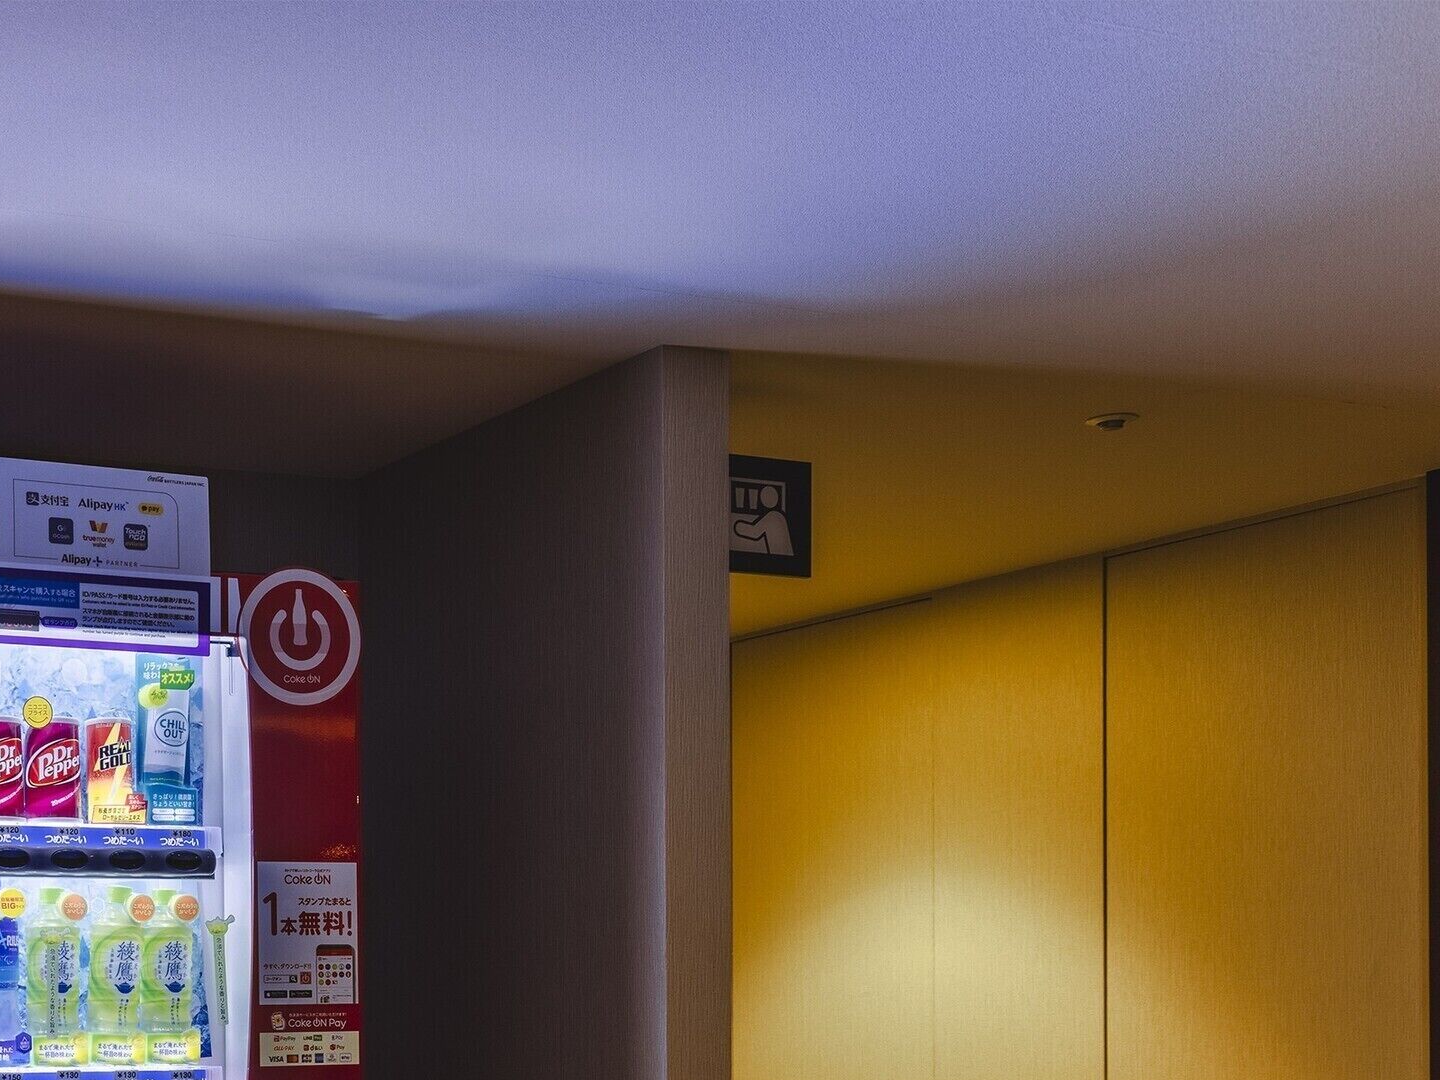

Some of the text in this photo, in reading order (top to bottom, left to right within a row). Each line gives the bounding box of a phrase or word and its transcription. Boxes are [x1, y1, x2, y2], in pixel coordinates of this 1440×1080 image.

[41, 495, 69, 506] 支付宝
[283, 674, 306, 684] Coke
[160, 718, 186, 731] CHILL
[164, 729, 183, 740] OUT
[53, 745, 73, 762] Dr
[284, 875, 312, 885] Coke
[298, 897, 352, 906] スタンプたまると
[116, 941, 135, 981] 綾鷹
[165, 941, 182, 981] 綾鷹
[288, 1019, 311, 1028] Coke
[329, 1019, 347, 1029] Pay
[60, 1071, 79, 1079] ¥130
[117, 1071, 136, 1079] ¥130
